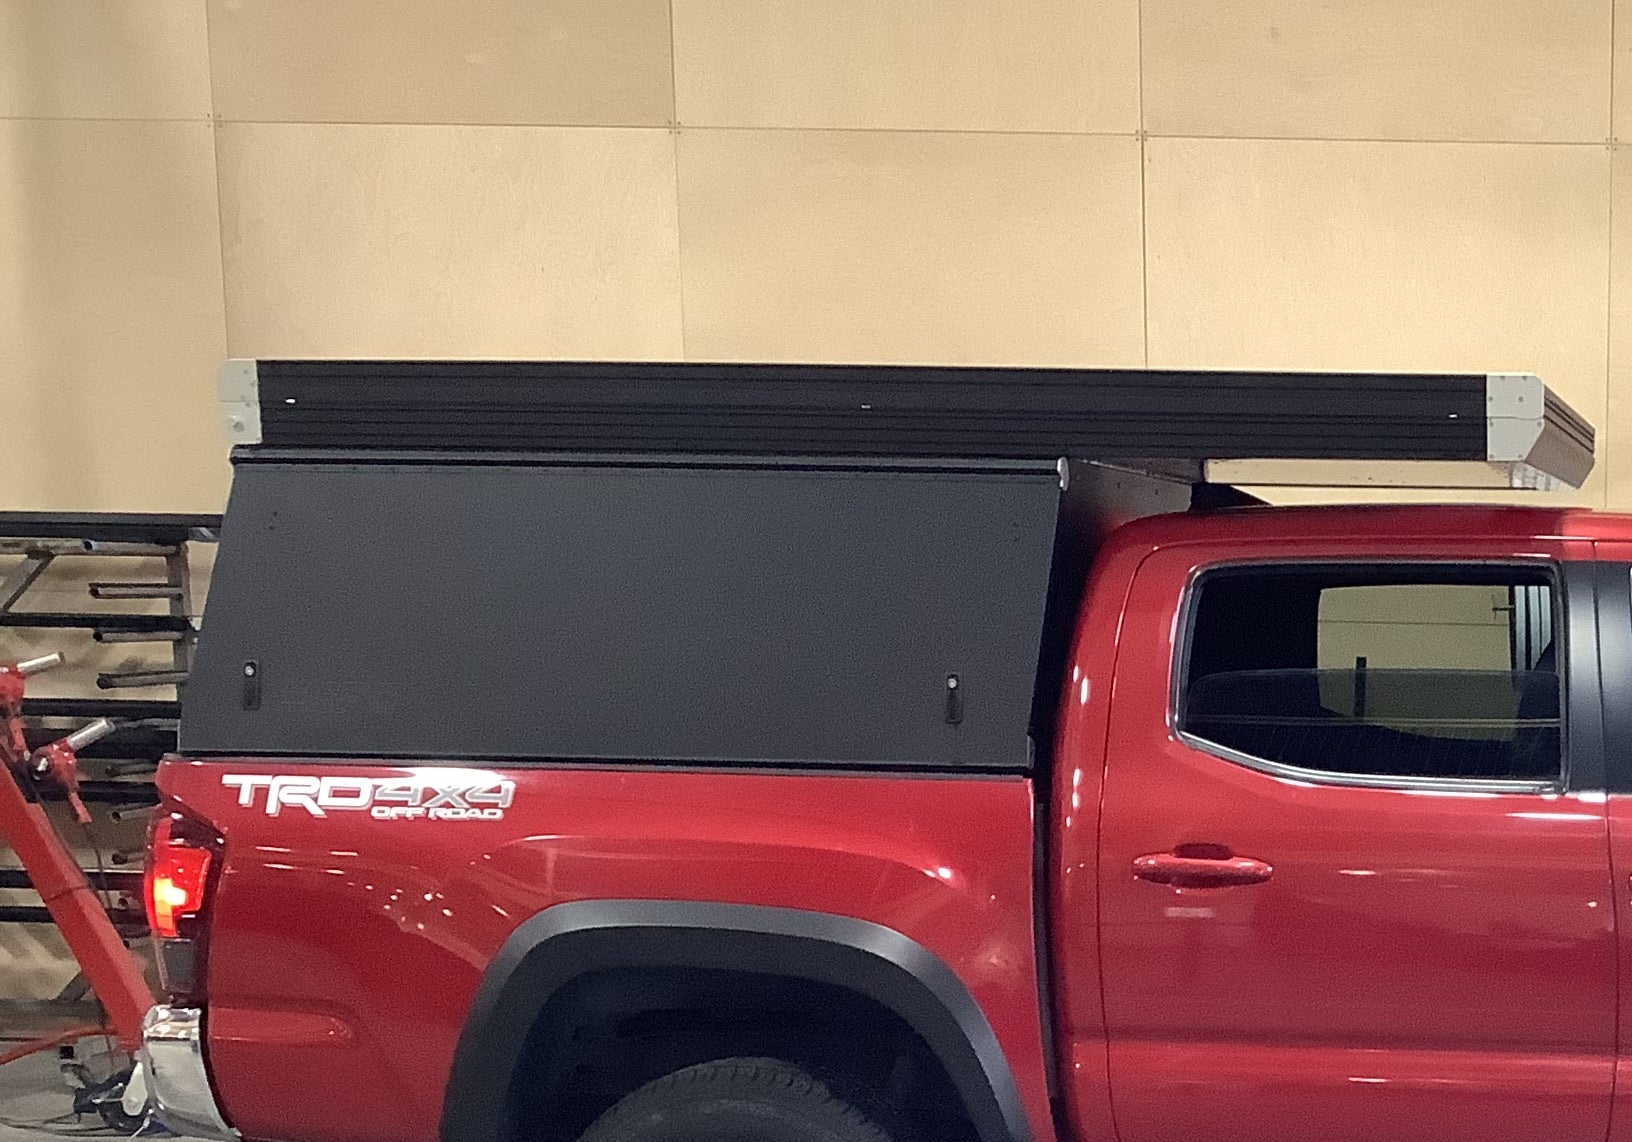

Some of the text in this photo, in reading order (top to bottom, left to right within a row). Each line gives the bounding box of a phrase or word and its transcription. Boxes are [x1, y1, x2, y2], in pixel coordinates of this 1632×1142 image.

[221, 774, 375, 818] TRD
[371, 805, 504, 820] OFF ROAD
